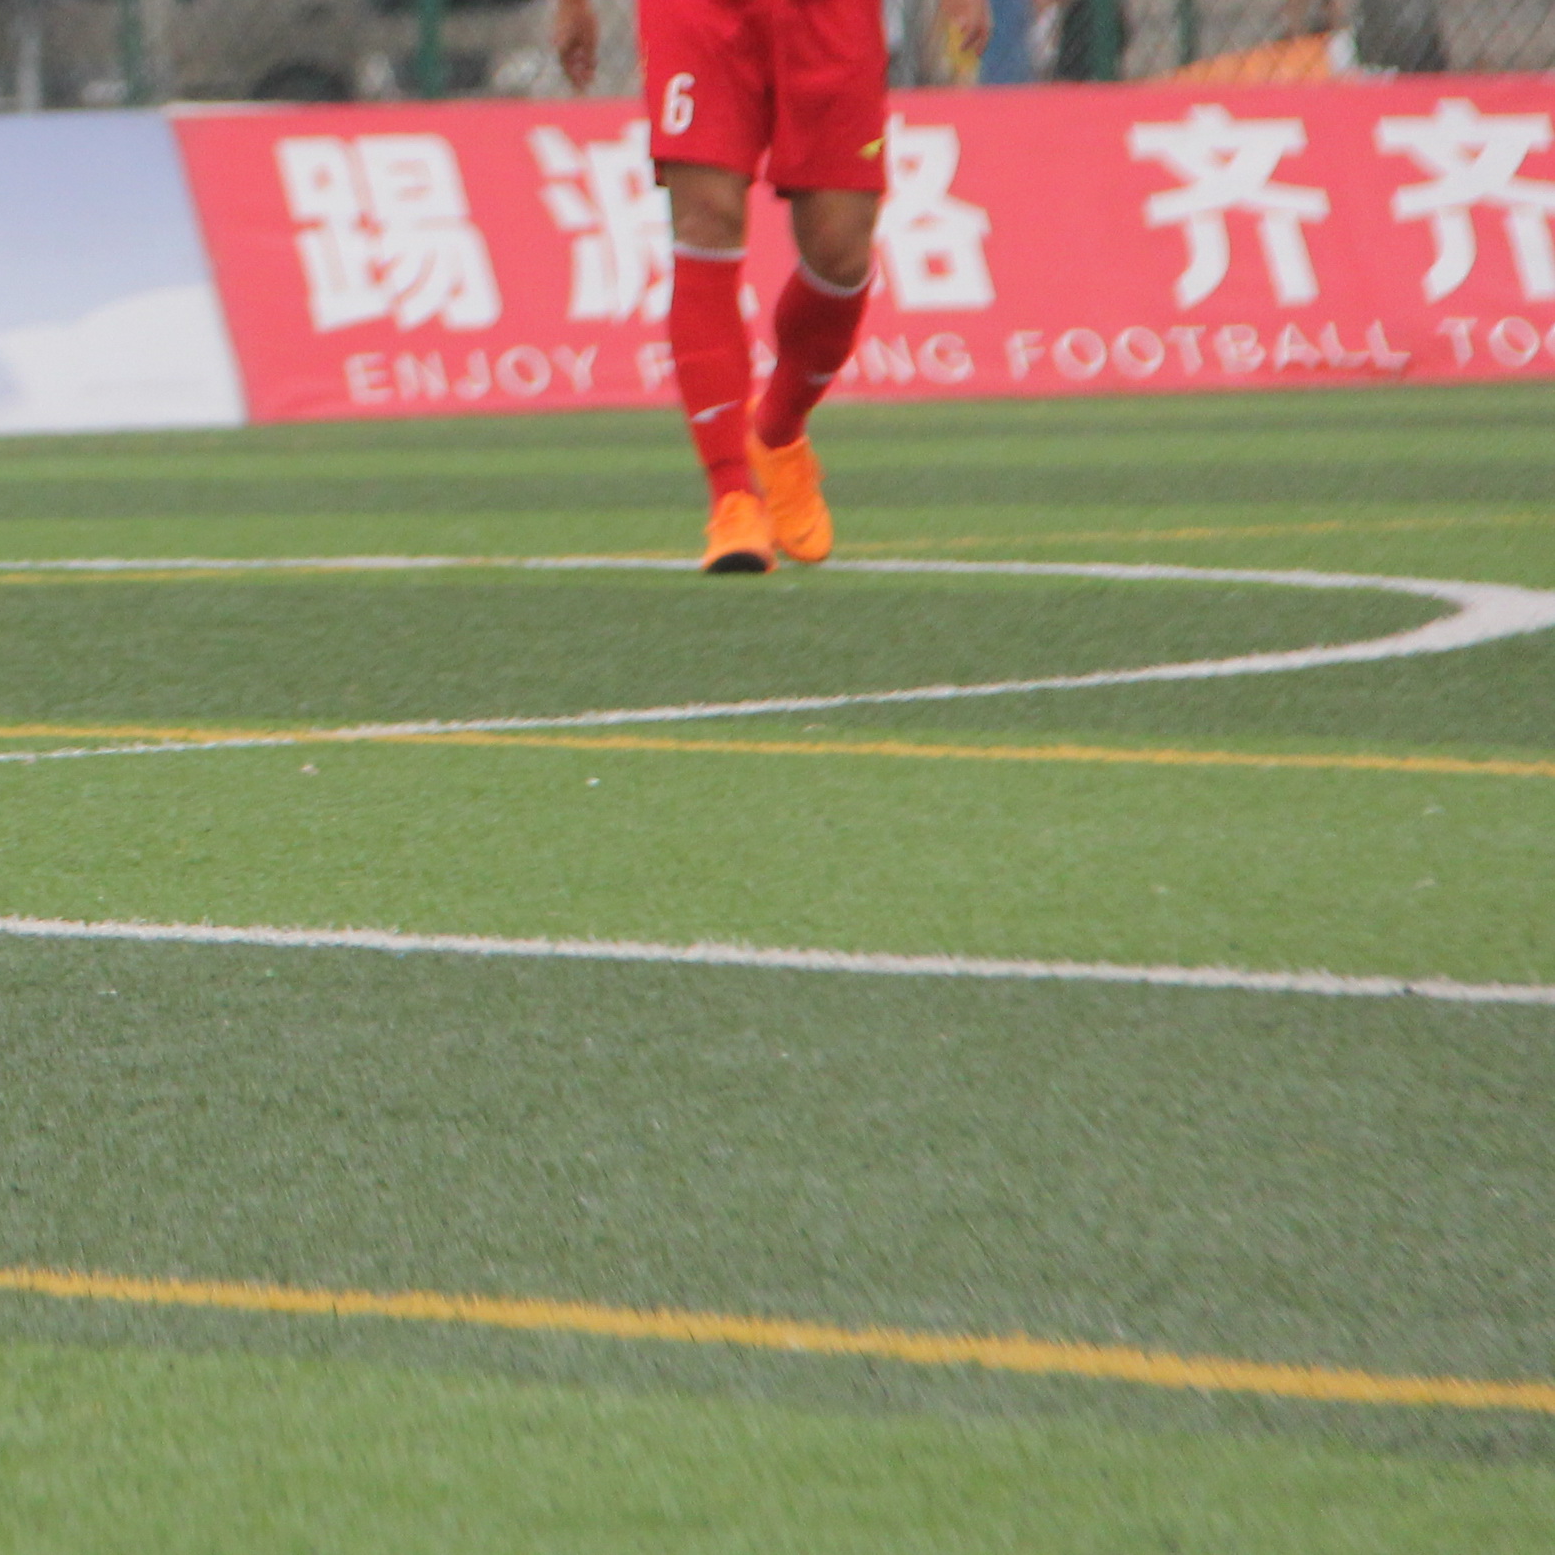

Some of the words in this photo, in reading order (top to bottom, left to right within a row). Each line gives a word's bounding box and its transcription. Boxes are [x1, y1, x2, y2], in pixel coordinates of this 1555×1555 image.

[662, 72, 695, 136] 6
[343, 341, 599, 405] ENJOY
[1005, 318, 1411, 383] FOOTBALL
[1437, 315, 1555, 371] TO
